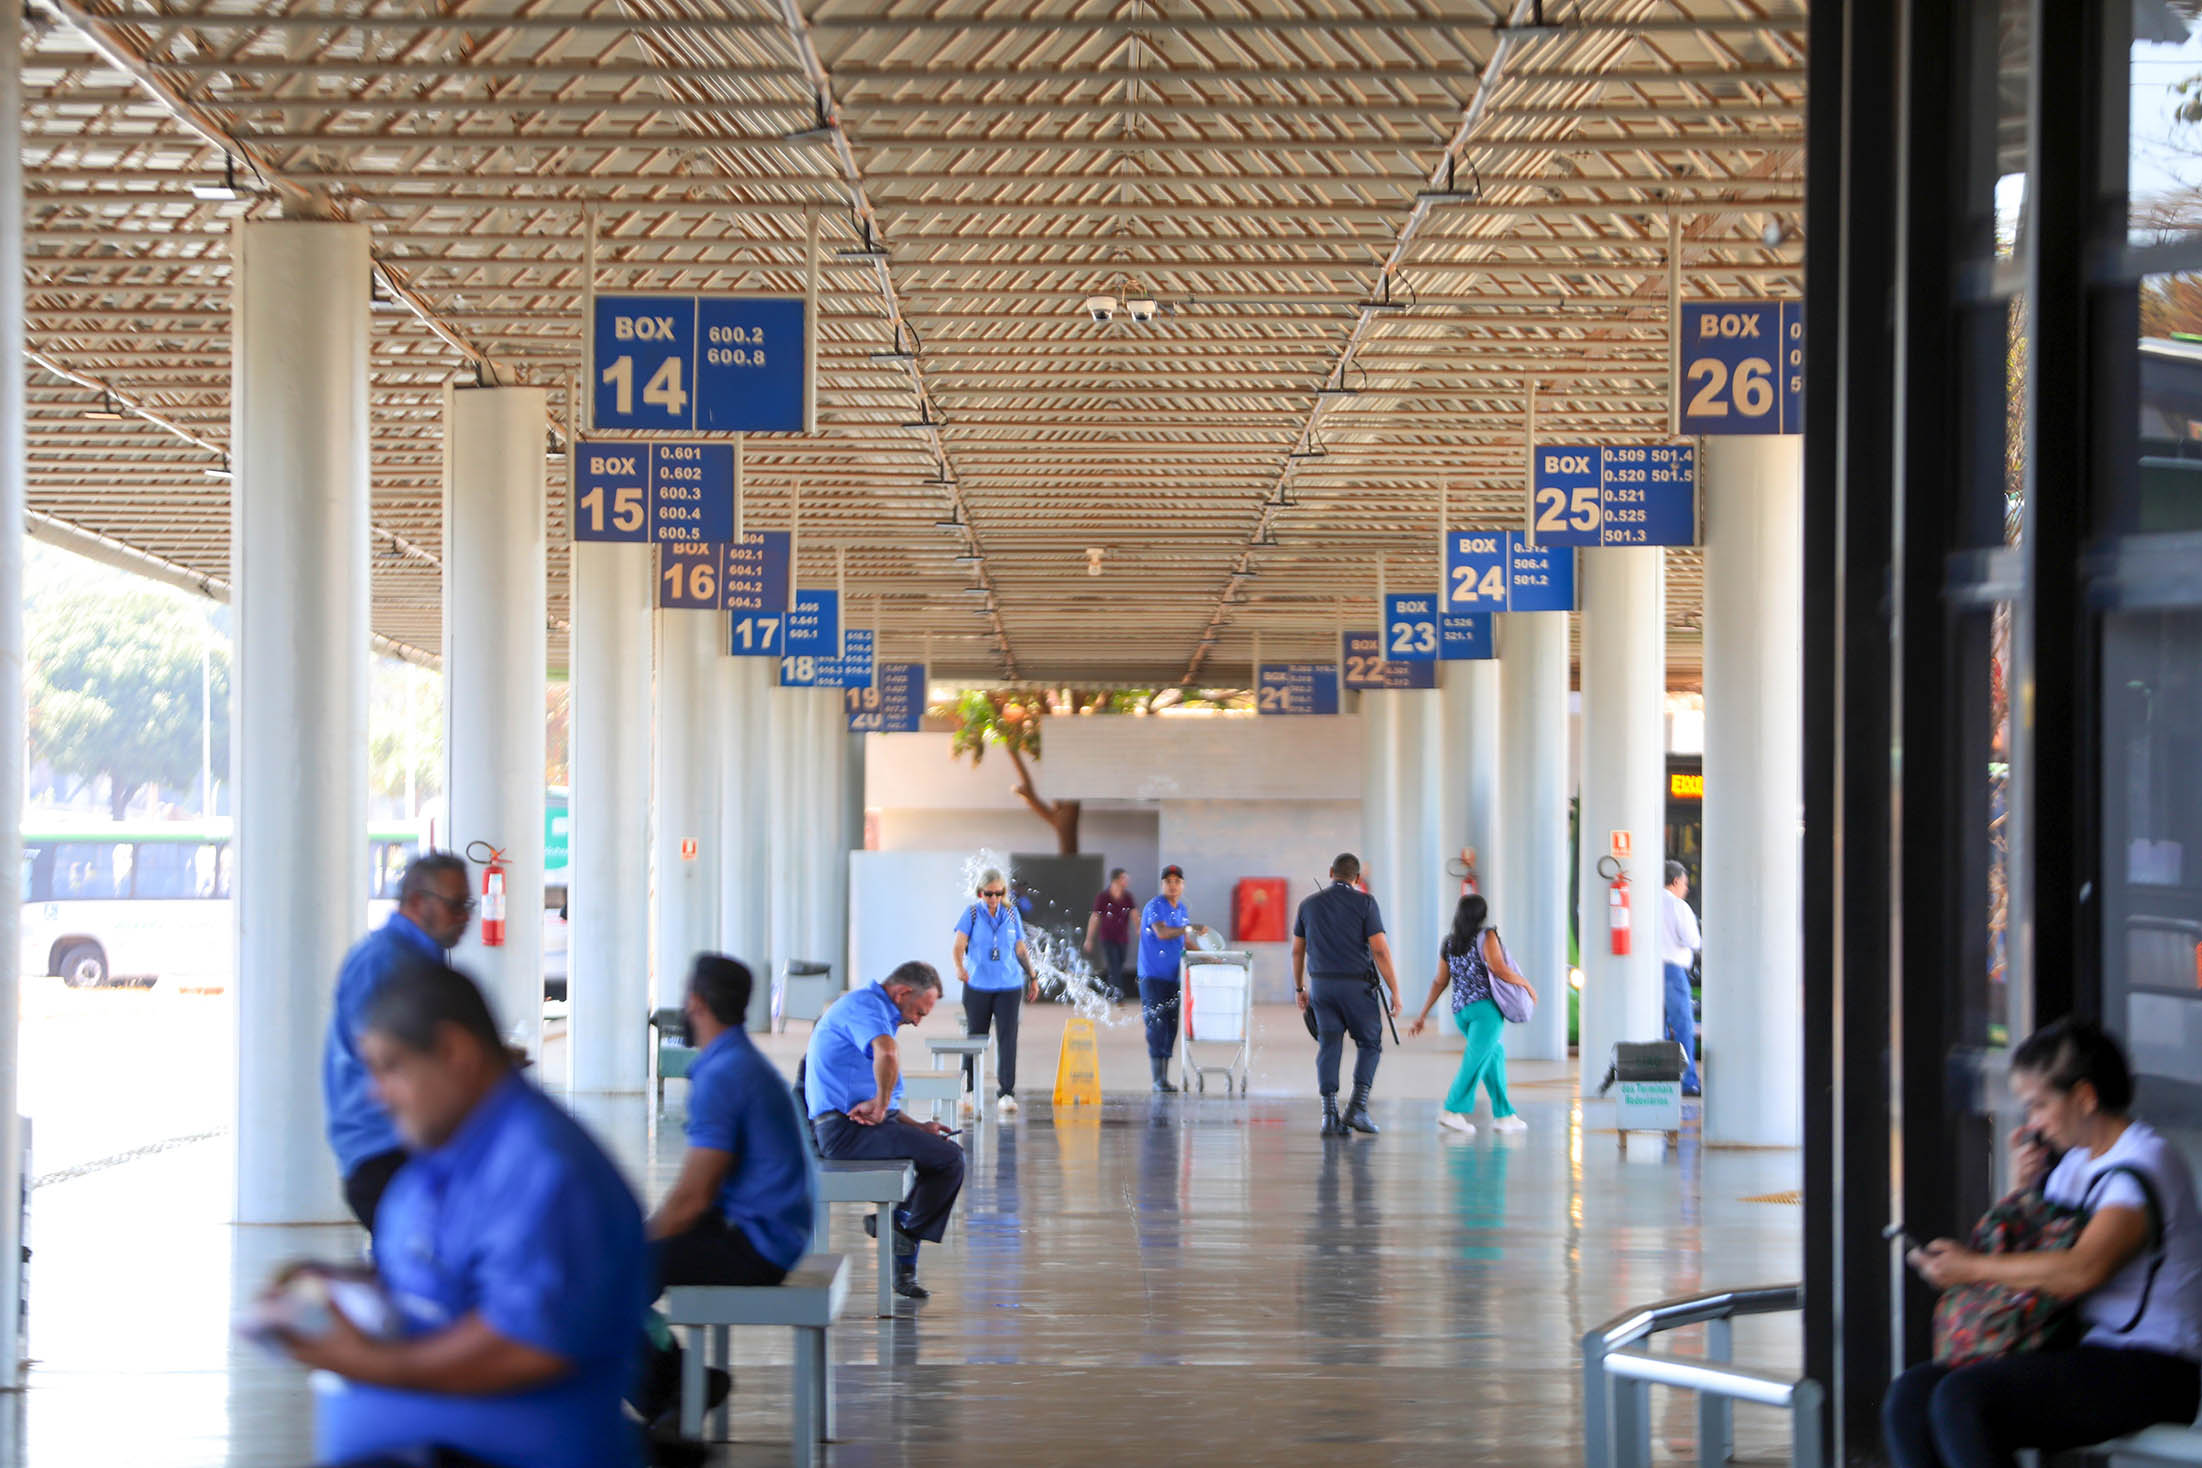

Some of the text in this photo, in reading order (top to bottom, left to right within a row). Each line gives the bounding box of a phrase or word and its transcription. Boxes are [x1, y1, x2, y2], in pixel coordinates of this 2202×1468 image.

[615, 317, 675, 340] BOX
[1700, 313, 1760, 338] BOX
[708, 327, 765, 344] 600.2
[707, 349, 766, 366] 600.8
[602, 355, 687, 415] 14
[1687, 357, 1774, 417] 26
[660, 447, 702, 460] 0.601
[1604, 450, 1693, 462] 0.509 501.4
[590, 457, 636, 475] BOX
[1545, 456, 1591, 474] BOX
[660, 467, 702, 480] 0.602
[1604, 470, 1693, 482] 0.520 501.5
[659, 487, 702, 500] 600.3
[1605, 490, 1646, 502] 0.521
[580, 486, 644, 533] 15
[659, 507, 701, 520] 600.4
[1535, 487, 1600, 532] 25
[1605, 510, 1647, 522] 0.525
[658, 527, 700, 539] 600.5
[743, 534, 764, 545] 604
[1605, 530, 1647, 542] 501.3
[673, 542, 710, 555] BOX
[1459, 539, 1497, 553] BOX
[730, 549, 764, 560] 602.1
[729, 565, 763, 576] 604.1
[1514, 559, 1549, 569] 506.4
[664, 563, 716, 601] 16
[728, 581, 763, 592] 604.2
[1451, 565, 1506, 601] 24
[1514, 575, 1548, 585] 501.2
[728, 597, 762, 608] 604.3
[1395, 601, 1428, 613] BOX
[736, 617, 780, 649] 17
[1391, 621, 1436, 652] 23
[1351, 639, 1378, 650] BOX
[782, 655, 815, 682] 18
[1346, 655, 1384, 681] 22
[847, 687, 880, 709] 19
[1260, 686, 1288, 709] 21
